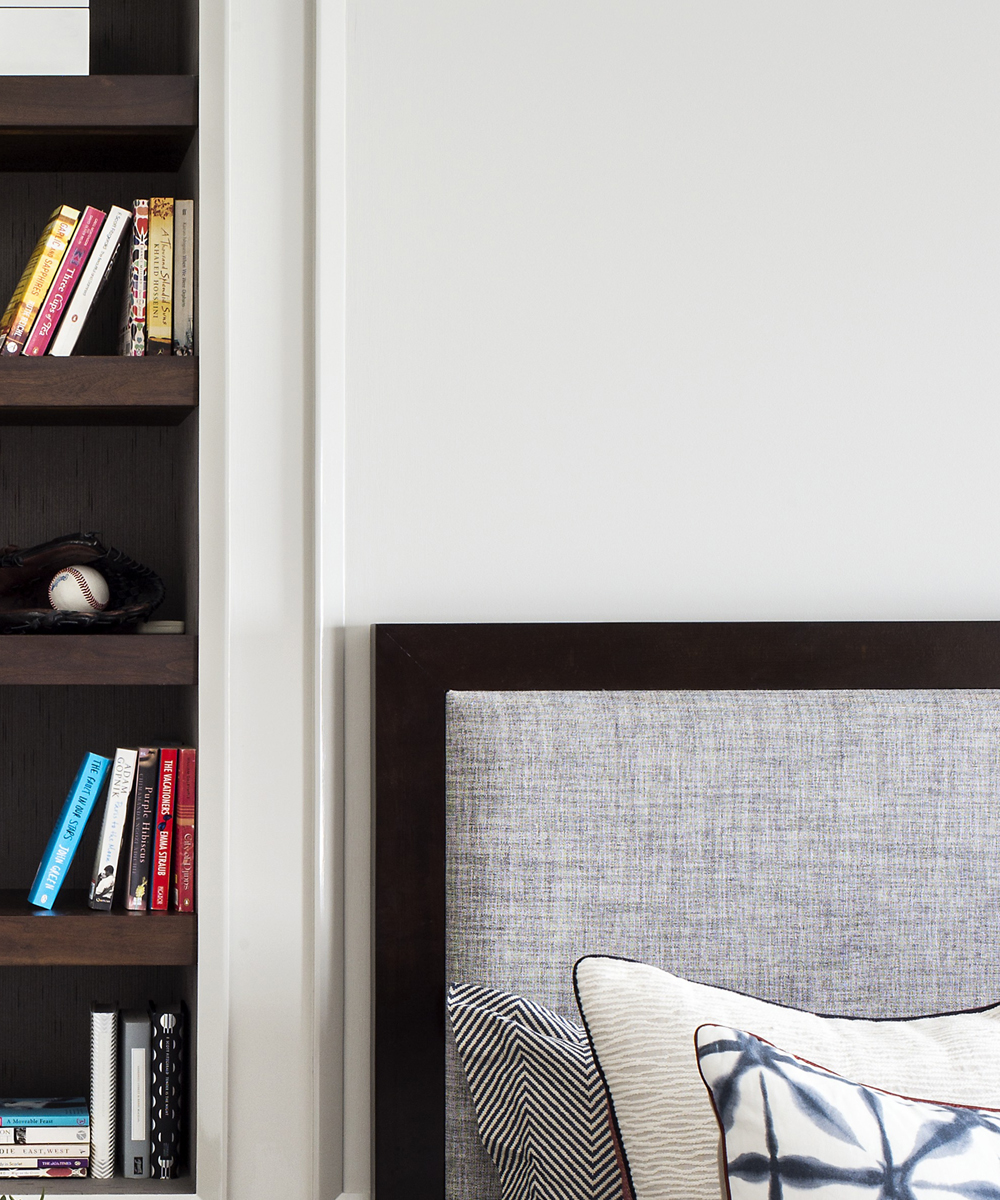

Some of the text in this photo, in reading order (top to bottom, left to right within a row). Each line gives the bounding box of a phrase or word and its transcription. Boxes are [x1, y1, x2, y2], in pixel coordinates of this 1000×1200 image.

[52, 222, 69, 247] GARLIC
[32, 258, 53, 296] SAPPHIRES
[58, 268, 75, 292] Three
[160, 227, 172, 324] A Thousand Splendid Suns
[49, 294, 63, 313] Cups
[39, 322, 52, 336] Tea
[112, 757, 124, 798] GOPNIK
[164, 760, 173, 772] THE
[120, 764, 132, 794] ADAM
[161, 774, 172, 815] VACATIONERS
[113, 801, 123, 820] Paris
[45, 760, 102, 891] THE FAULT IN OUR STARS JOHN GREEN
[109, 831, 117, 842] the
[140, 787, 153, 863] Purple Hibiscus
[159, 831, 168, 850] EMMA
[184, 834, 192, 851] City
[106, 844, 115, 862] Moon
[157, 852, 168, 876] STRAUB
[182, 863, 191, 890] Djinns
